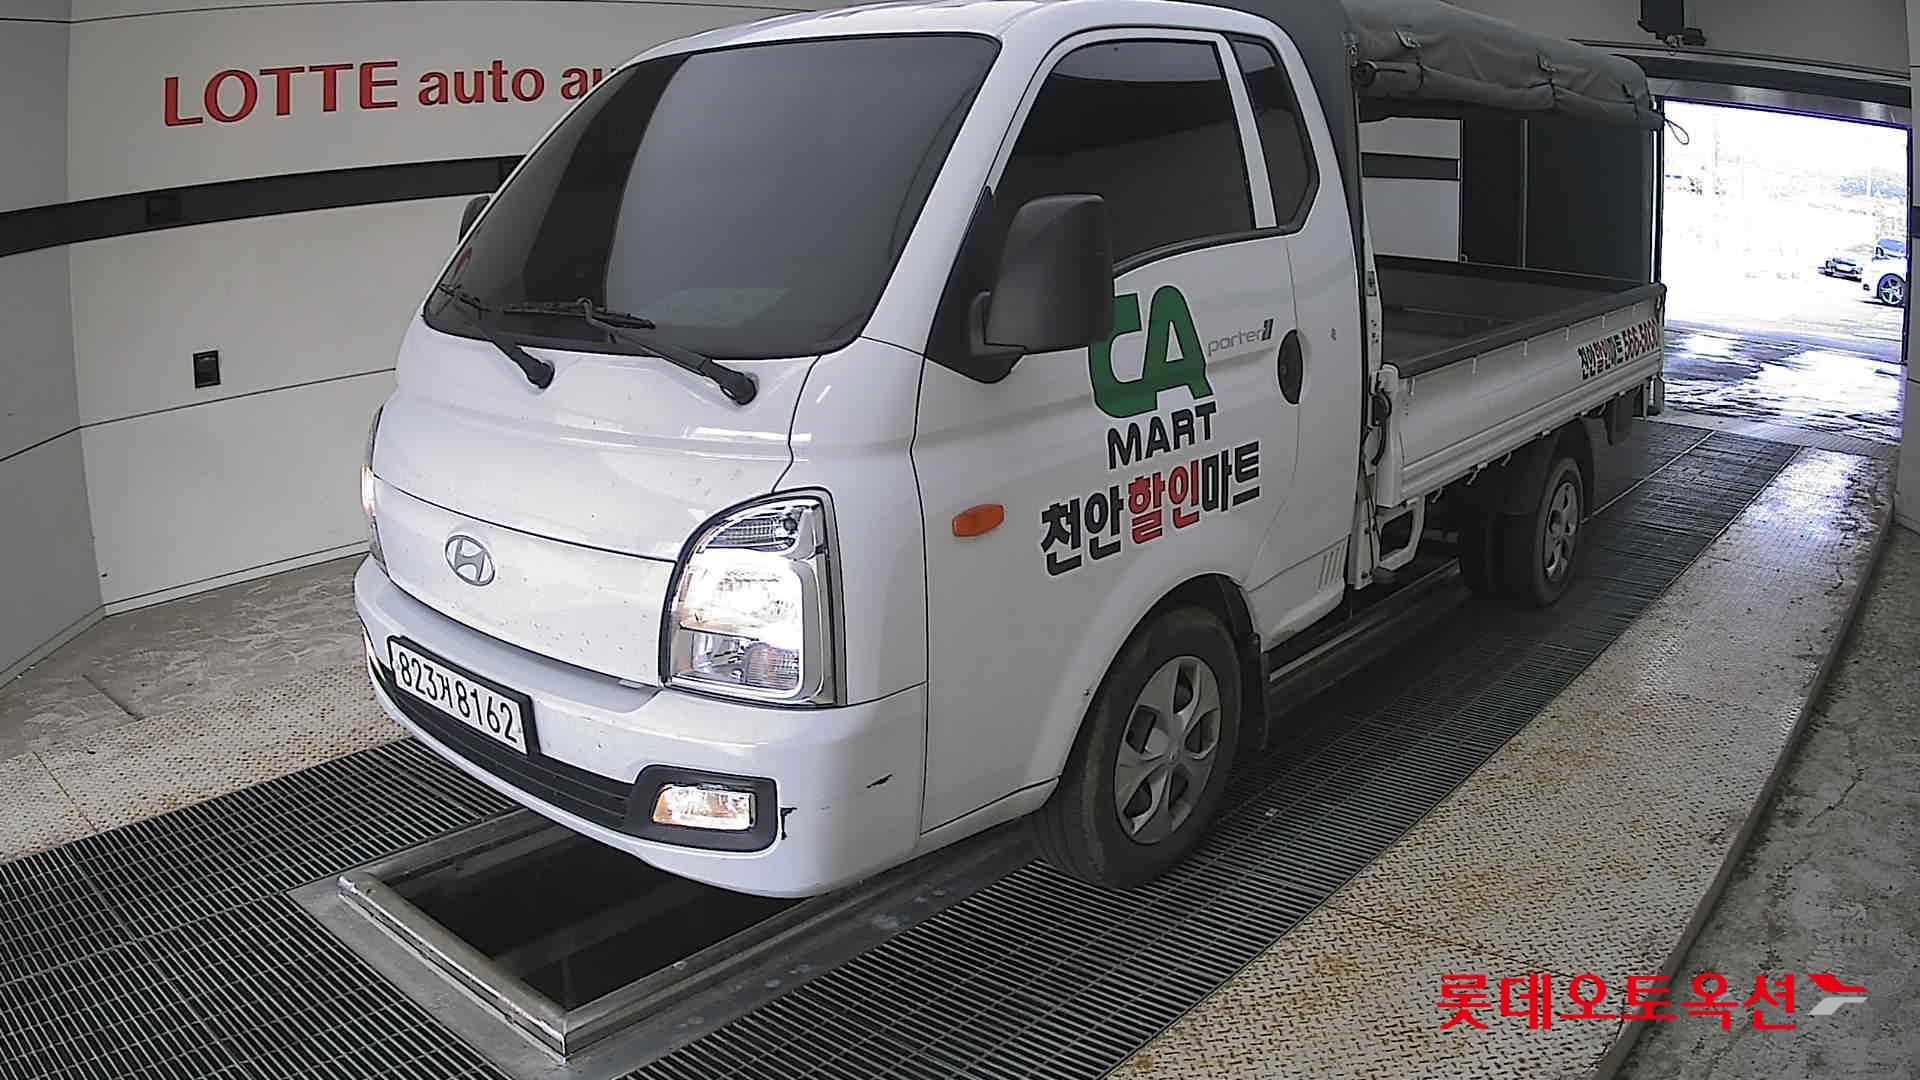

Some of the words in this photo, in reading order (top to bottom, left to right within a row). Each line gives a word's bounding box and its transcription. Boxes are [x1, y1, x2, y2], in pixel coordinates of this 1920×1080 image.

[164, 60, 398, 127] LOTTE
[418, 60, 546, 105] auto
[1106, 401, 1217, 470] MART
[1040, 440, 1261, 577] 천안할인마트
